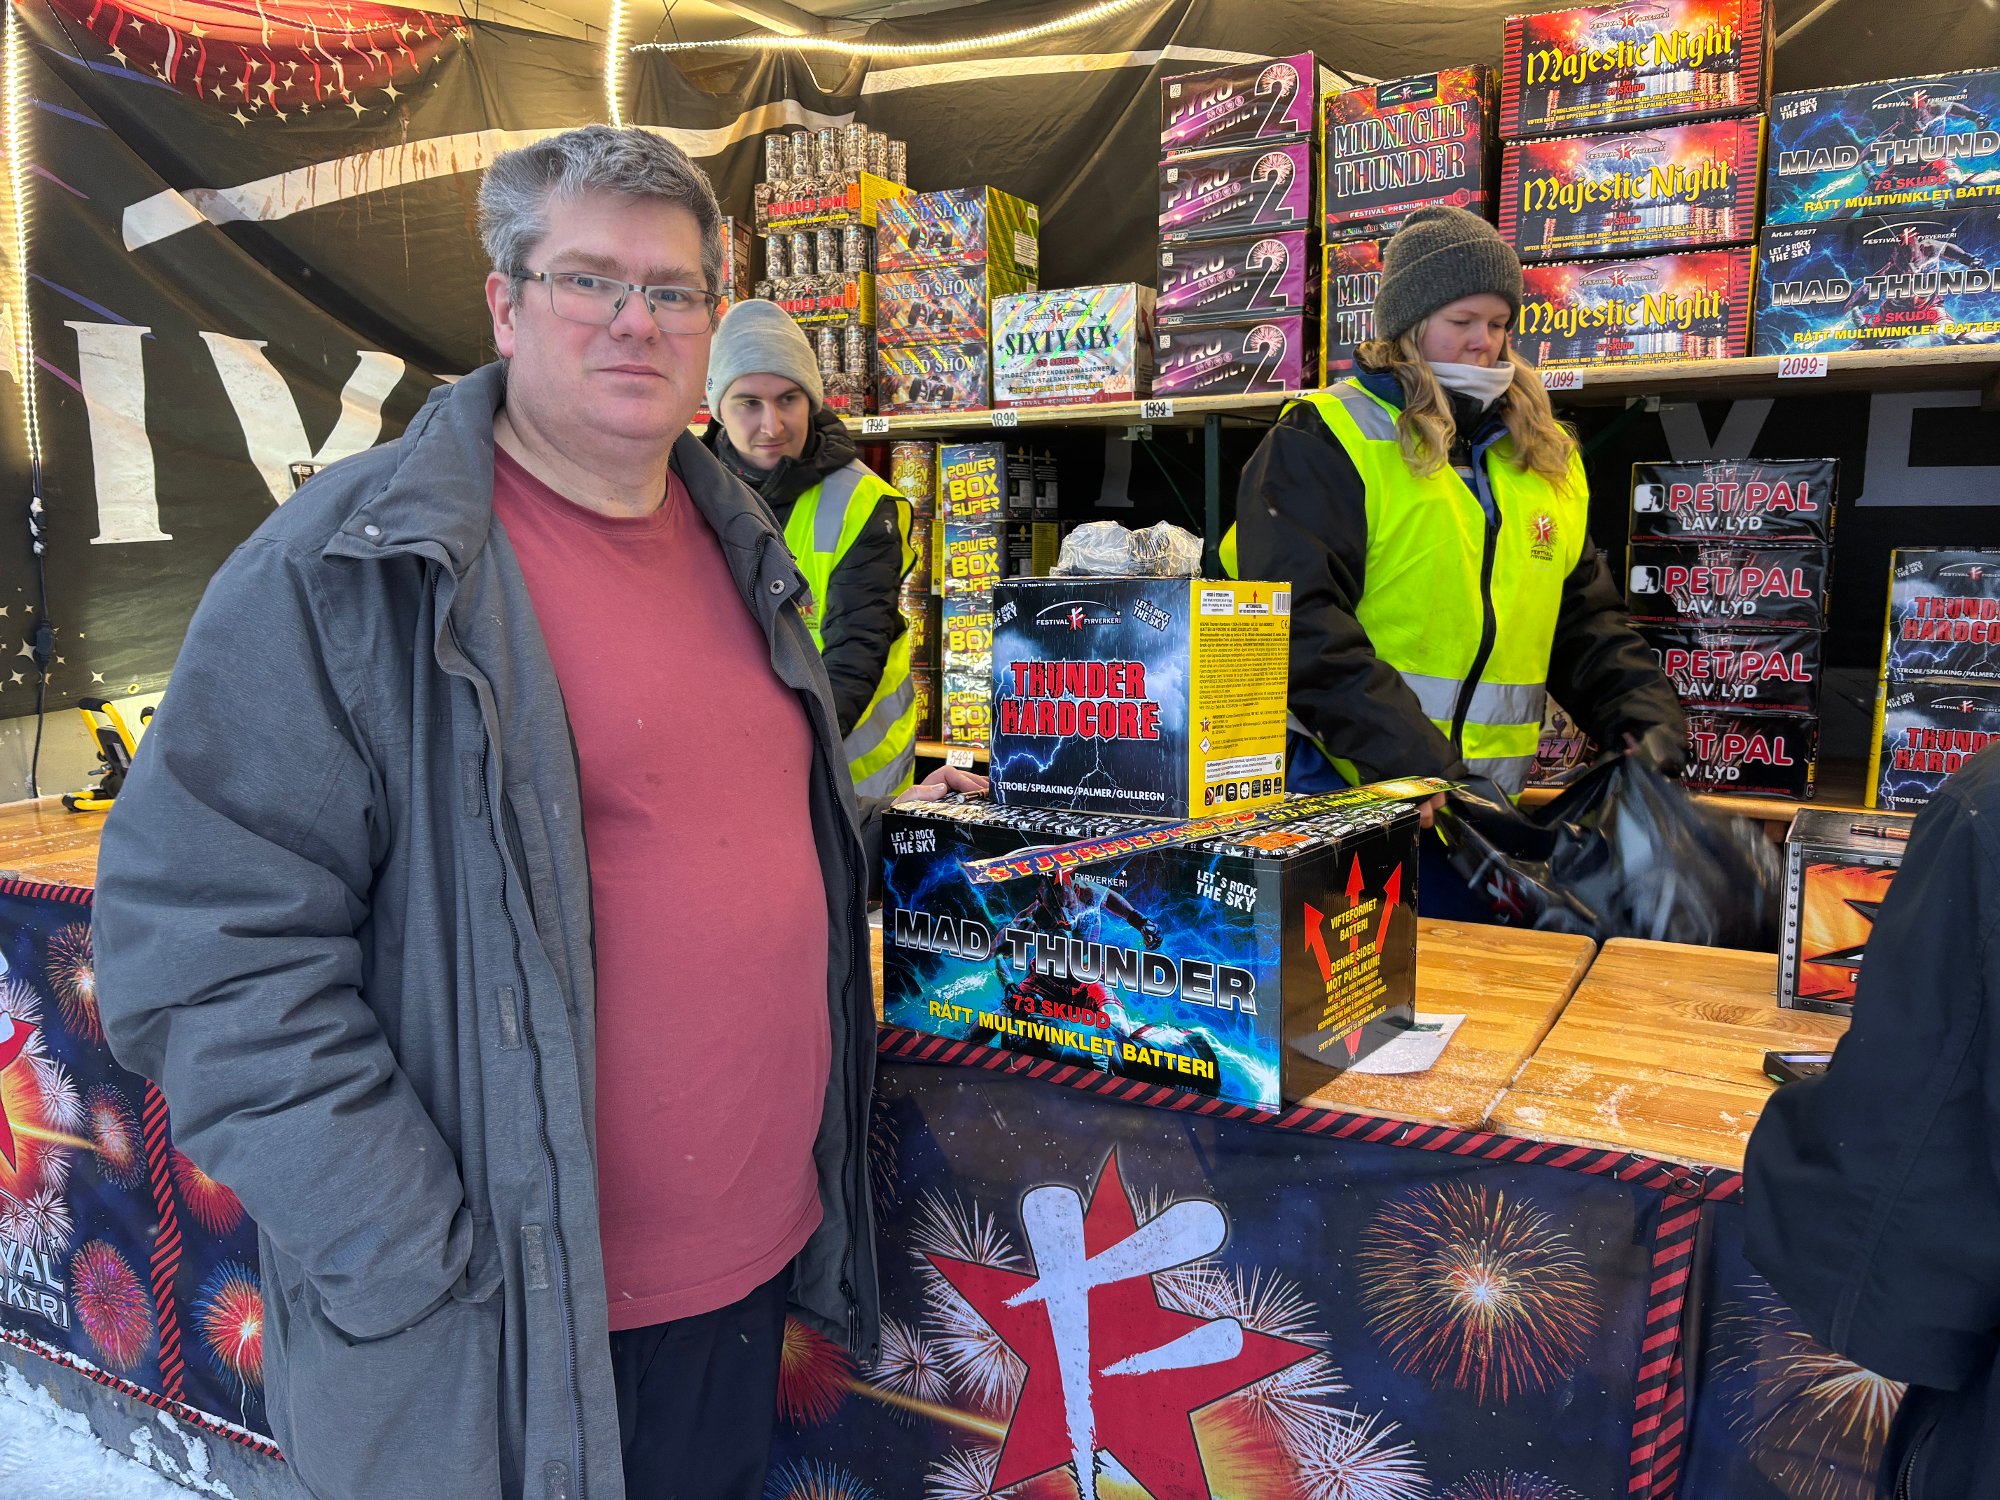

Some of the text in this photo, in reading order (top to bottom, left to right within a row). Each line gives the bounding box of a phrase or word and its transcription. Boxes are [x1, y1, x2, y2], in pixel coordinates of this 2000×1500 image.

[1527, 23, 1732, 85] Majestic Night
[1619, 83, 1645, 94] SKUDD
[1170, 79, 1233, 124] PYRO
[1255, 63, 1300, 139] 2
[1781, 103, 1818, 120] THE SKY
[1799, 97, 1818, 108] ROCK
[1872, 101, 1911, 110] FESTIVAL
[1335, 101, 1467, 158] MIDNIGHT
[1779, 131, 2000, 177] MAD THUND
[1335, 142, 1465, 198] THUNDER
[1167, 167, 1231, 209] PYRO
[1251, 151, 1296, 225] 2
[1524, 160, 1731, 213] Majestic Night
[1874, 174, 1949, 191] 73 SKUDD
[768, 199, 816, 217] THUNDER
[1350, 198, 1444, 218] FESTIVAL PREMIUM LINE
[1804, 185, 2000, 212] RÅTT MULTIVINKLET BATTE
[885, 200, 977, 224] SPEED SHOW
[1615, 215, 1641, 225] SKUDD
[1794, 228, 1817, 236] 60277
[1863, 233, 1957, 245] FESTIVAL FYRVERKERI
[1770, 247, 1811, 263] THE SKY
[1791, 240, 1811, 249] ROCK
[1162, 254, 1225, 292] PYRO
[1246, 239, 1290, 311] 2
[1579, 278, 1611, 286] FESTIVAL
[885, 279, 977, 300] SPEED SHOW
[1772, 268, 2000, 306] MAD THUND
[1519, 289, 1721, 337] Majestic Night
[1863, 310, 1938, 324] 73 SKUDD
[1005, 325, 1112, 356] SIXTY SIX
[1794, 324, 1941, 343] RÅTT MULTIVINKLET
[1160, 336, 1222, 374] PYRO
[1608, 341, 1634, 349] SKUDD
[886, 355, 979, 376] SPEED SHOW
[1050, 357, 1079, 365] SKUDD
[1242, 324, 1287, 395] 2
[1012, 386, 1034, 394] DENNE
[1042, 397, 1073, 405] PREMIUM
[948, 458, 996, 478] POWER
[949, 473, 999, 501] BOX
[1668, 481, 1818, 513] PET PAL
[952, 497, 1000, 516] SUPER
[1682, 516, 1763, 531] LAV LYD
[950, 537, 997, 554] POWER
[951, 552, 1000, 578] BOX
[955, 576, 1000, 592] SUPER
[1664, 566, 1812, 598] PET PAL
[1002, 600, 1016, 614] ROCK
[1002, 604, 1018, 621] SKY
[1153, 608, 1171, 623] ROCK
[1677, 600, 1757, 615] LAV LYD
[1915, 597, 2000, 620] THUND
[948, 613, 992, 628] POWER
[1133, 607, 1169, 632] THE SKY
[1665, 648, 1813, 683] PET PAL
[1897, 667, 2000, 678] STROBE/SPRAKING/PALMER/
[1010, 661, 1147, 699] THUNDER
[1678, 681, 1758, 698] LAV LYD
[1000, 700, 1160, 741] HARDCORE
[952, 728, 990, 740] SUPE
[1537, 738, 1582, 759] AZY
[1722, 735, 1793, 766] PAL
[1704, 765, 1740, 781] LYD
[998, 781, 1165, 802] STROBE/SPRAKING/PALMER/GULLREGN
[915, 829, 935, 840] ROCK
[893, 839, 936, 854] THE SKY
[1074, 873, 1128, 887] FYRVERKERI
[1230, 880, 1258, 898] ROCK
[1196, 881, 1257, 913] THE SKY
[1331, 897, 1377, 929] VIFTEFORMET
[1340, 918, 1368, 942] BATTERI
[895, 908, 991, 961] MAD
[1005, 928, 1257, 1015] THUNDER
[1331, 940, 1376, 975] DENNE SIDEN
[1326, 954, 1381, 994] MOT PUBLIKUM!
[1013, 994, 1111, 1030] 73 SKUDD
[928, 997, 1215, 1079] RÅTT MULTIVINKLET BATTERI
